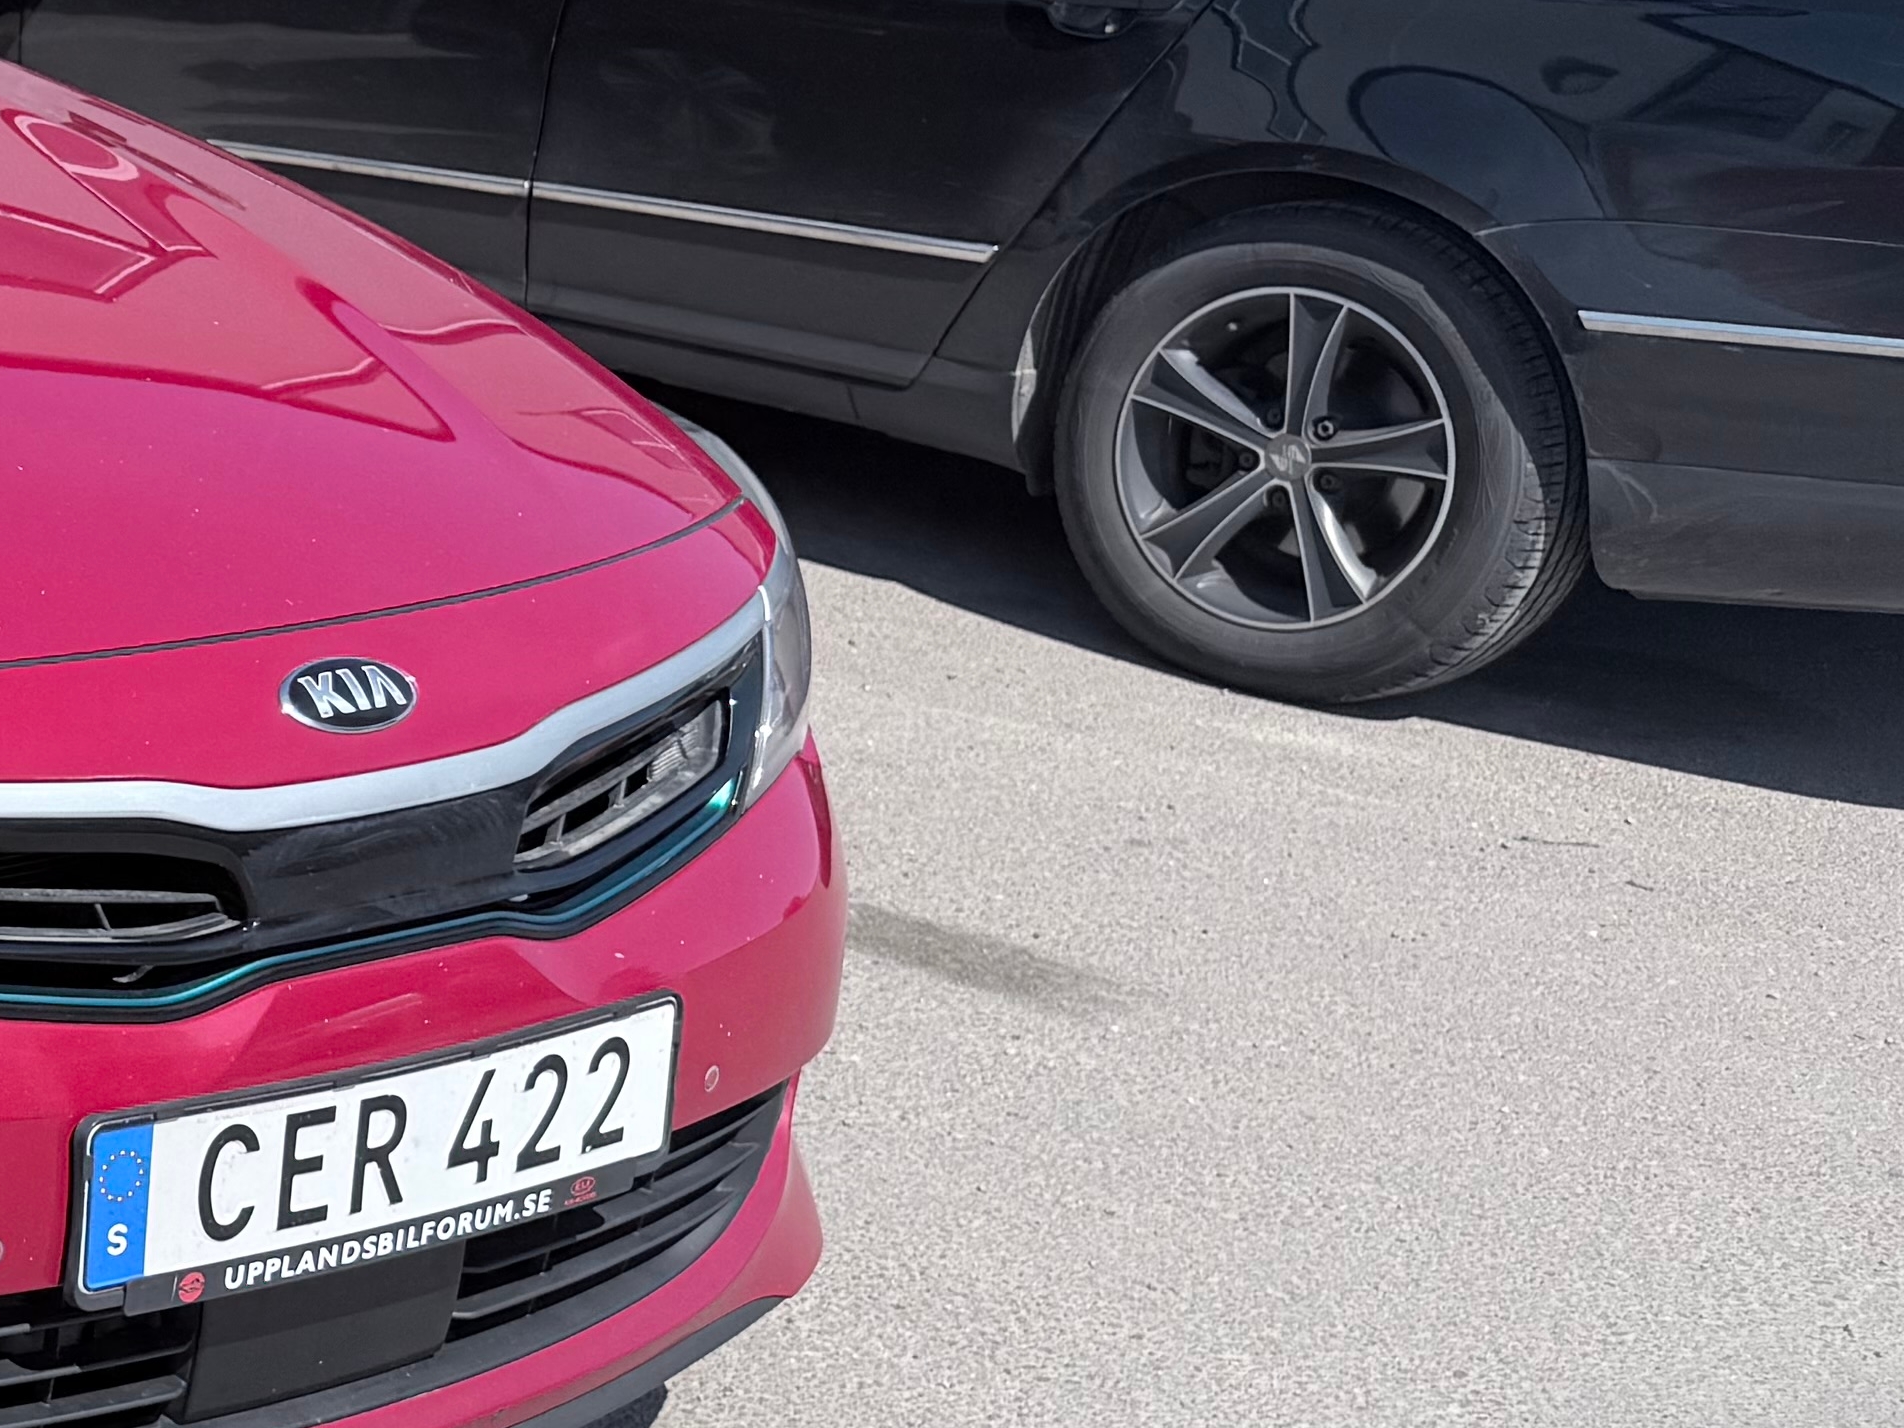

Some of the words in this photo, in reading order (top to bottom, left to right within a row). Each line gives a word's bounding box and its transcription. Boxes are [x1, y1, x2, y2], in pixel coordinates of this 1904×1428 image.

[296, 664, 408, 719] KIA
[197, 1094, 409, 1243] CER
[447, 1035, 632, 1185] 422
[105, 1223, 128, 1257] S
[223, 1188, 553, 1291] UPPLANDSBILFORUM.SE
